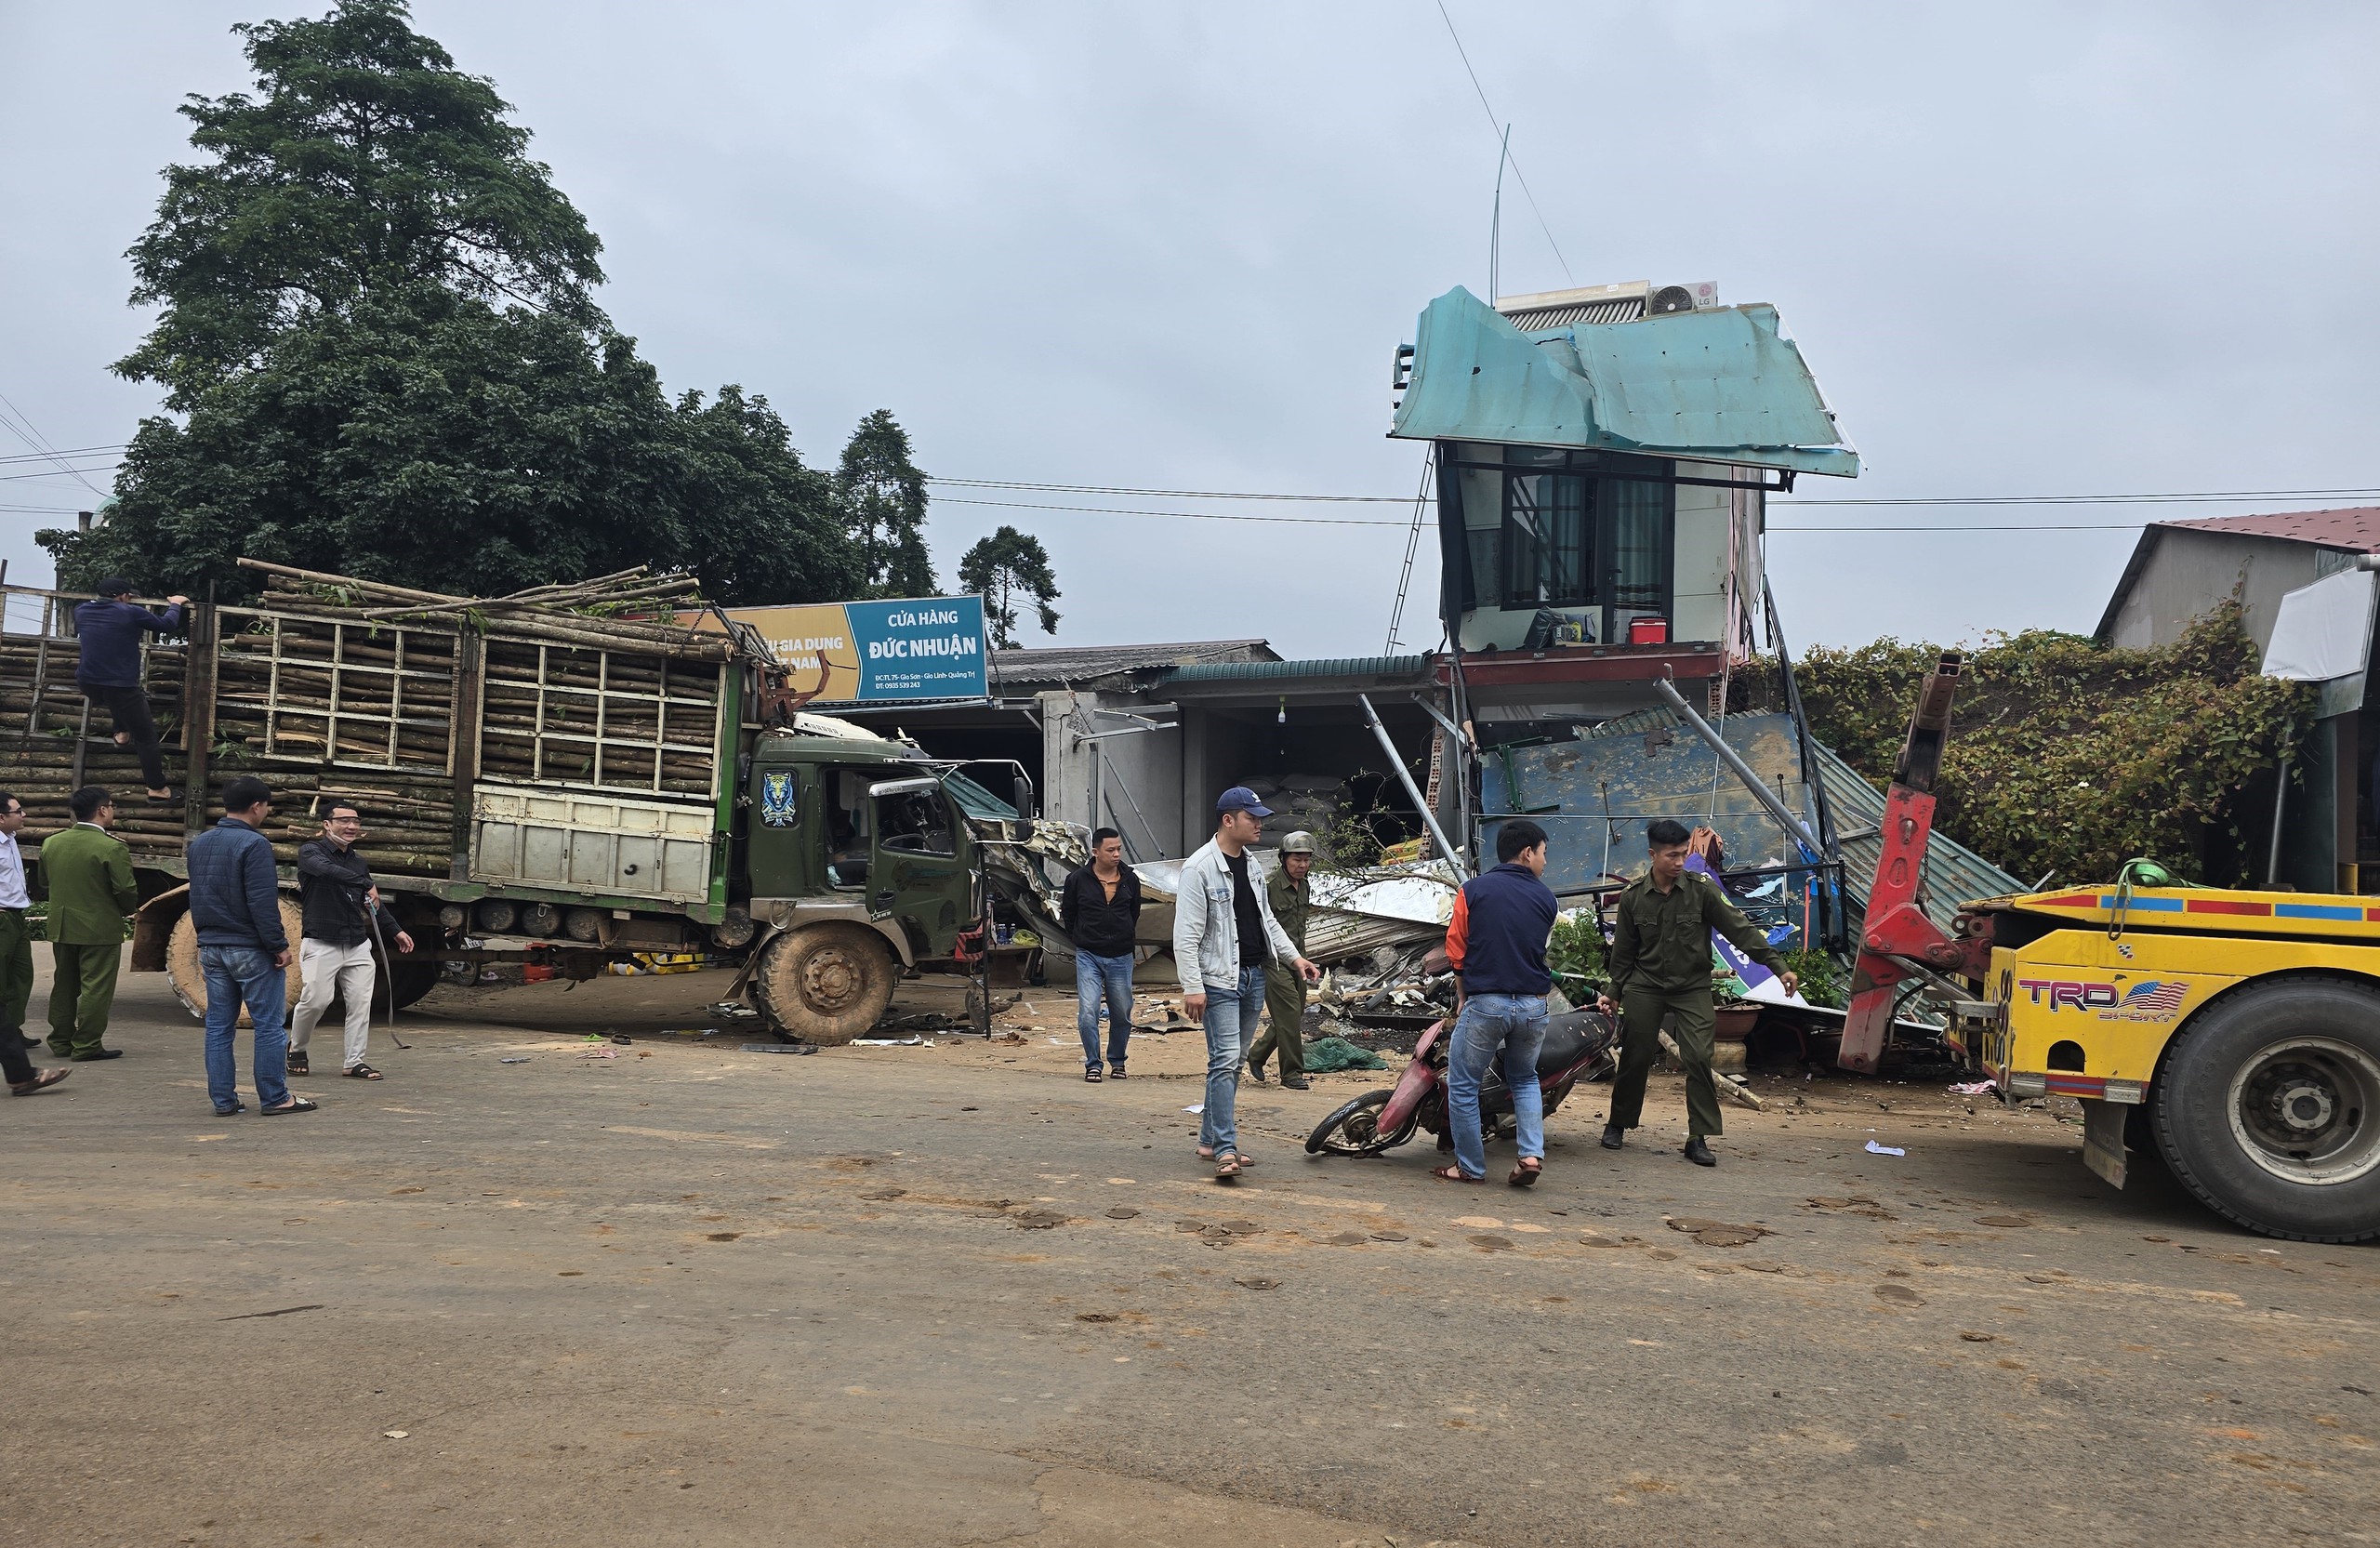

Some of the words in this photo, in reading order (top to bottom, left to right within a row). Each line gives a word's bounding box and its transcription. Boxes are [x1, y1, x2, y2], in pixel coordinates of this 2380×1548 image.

[888, 610, 916, 627] CỬA
[919, 609, 959, 625] HÀNG
[780, 639, 803, 652] GIA
[869, 637, 907, 658] ĐỨC
[910, 633, 976, 660] NHUẬN
[2018, 979, 2119, 1012] TRD
[2098, 1009, 2176, 1022] SPORT
